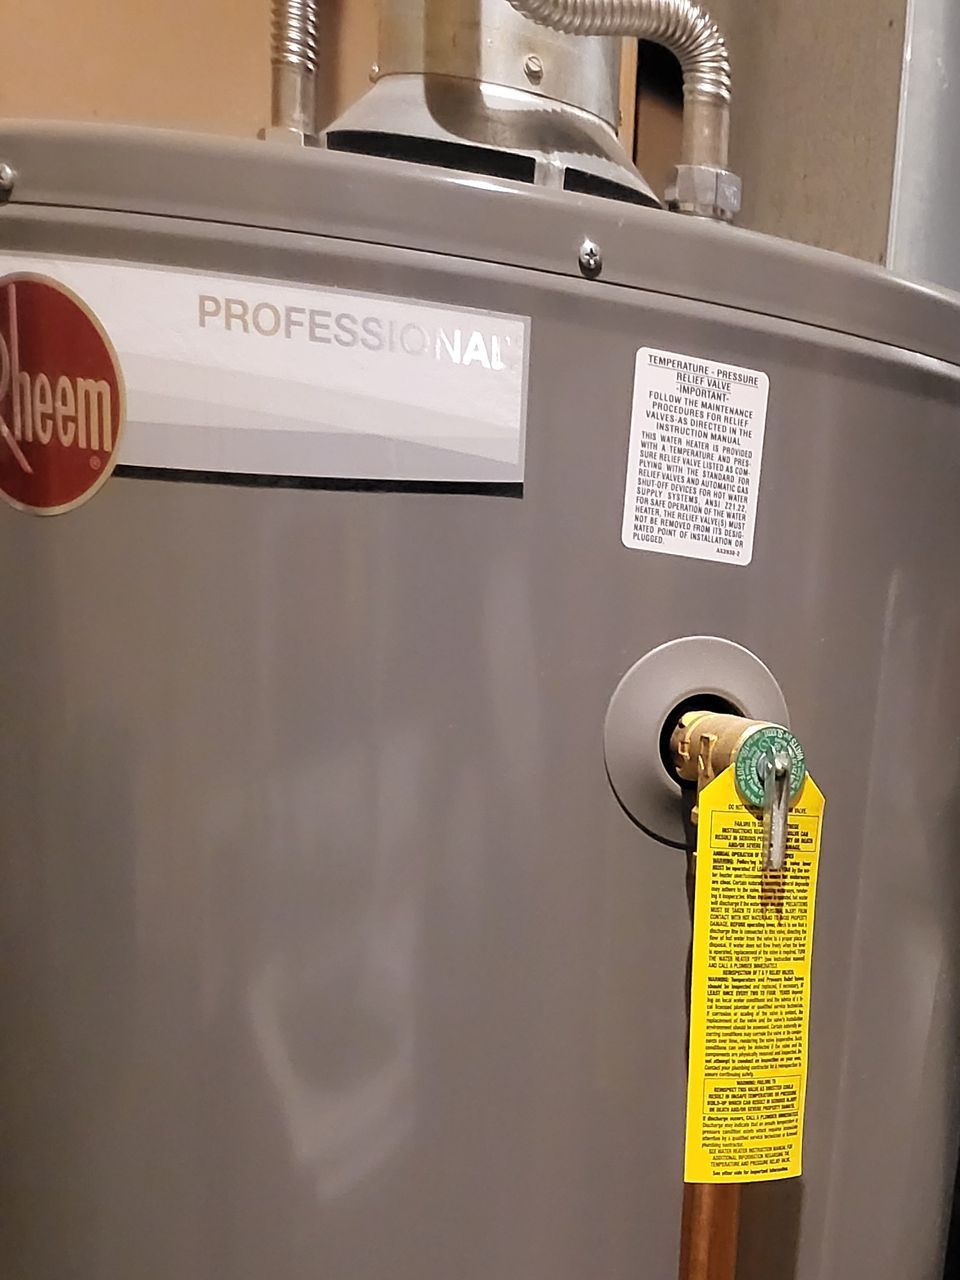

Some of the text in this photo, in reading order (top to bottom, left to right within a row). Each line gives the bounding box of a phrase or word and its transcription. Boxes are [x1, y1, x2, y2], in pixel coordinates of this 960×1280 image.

[199, 294, 505, 370] PROFESSIONAL
[649, 354, 758, 385] TEMPERATURE PRESSURE
[676, 372, 730, 391] RELIEF VALVE
[649, 391, 752, 418] FOLLOW THE MAINTENANCE
[652, 401, 748, 427] PROCEDURES FOR RELIEF
[656, 422, 740, 445] INSTRUCTION MANUAL
[690, 419, 726, 432] DIRECTED
[729, 426, 736, 435] IN
[739, 428, 751, 438] THE
[641, 440, 657, 450] WITH
[670, 445, 713, 460] TEMPERATURE
[718, 454, 730, 463] AND
[642, 431, 752, 458] THIS WATER HEATER IS PROVIDED
[639, 459, 749, 485] PLYING WITH THE STANDARD FOR
[640, 450, 656, 459] SURE
[659, 453, 680, 463] RELIEF
[682, 457, 700, 467] VALVE
[702, 461, 723, 471] LISTED
[725, 465, 733, 473] AS
[638, 468, 748, 494] RELIEF VALVES AND AUTOMATIC GAS
[638, 477, 747, 503] SHUT-OFF DEVICES FOR HOT WATER
[636, 496, 745, 521] FOR SAFE OPERATION OF THE WATER
[637, 486, 662, 497] SUPPLY
[705, 498, 720, 507] ANSI
[634, 514, 647, 522] NOT
[650, 517, 657, 525] BE
[660, 518, 690, 530] REMOVED
[693, 524, 710, 533] FROM
[712, 527, 721, 535] ITS
[635, 505, 661, 516] HEATER,
[664, 509, 674, 518] THE
[677, 512, 697, 522] RELIEF
[728, 521, 745, 530] MUST
[634, 524, 743, 547] NATED POINT OF INSTALLATION OR
